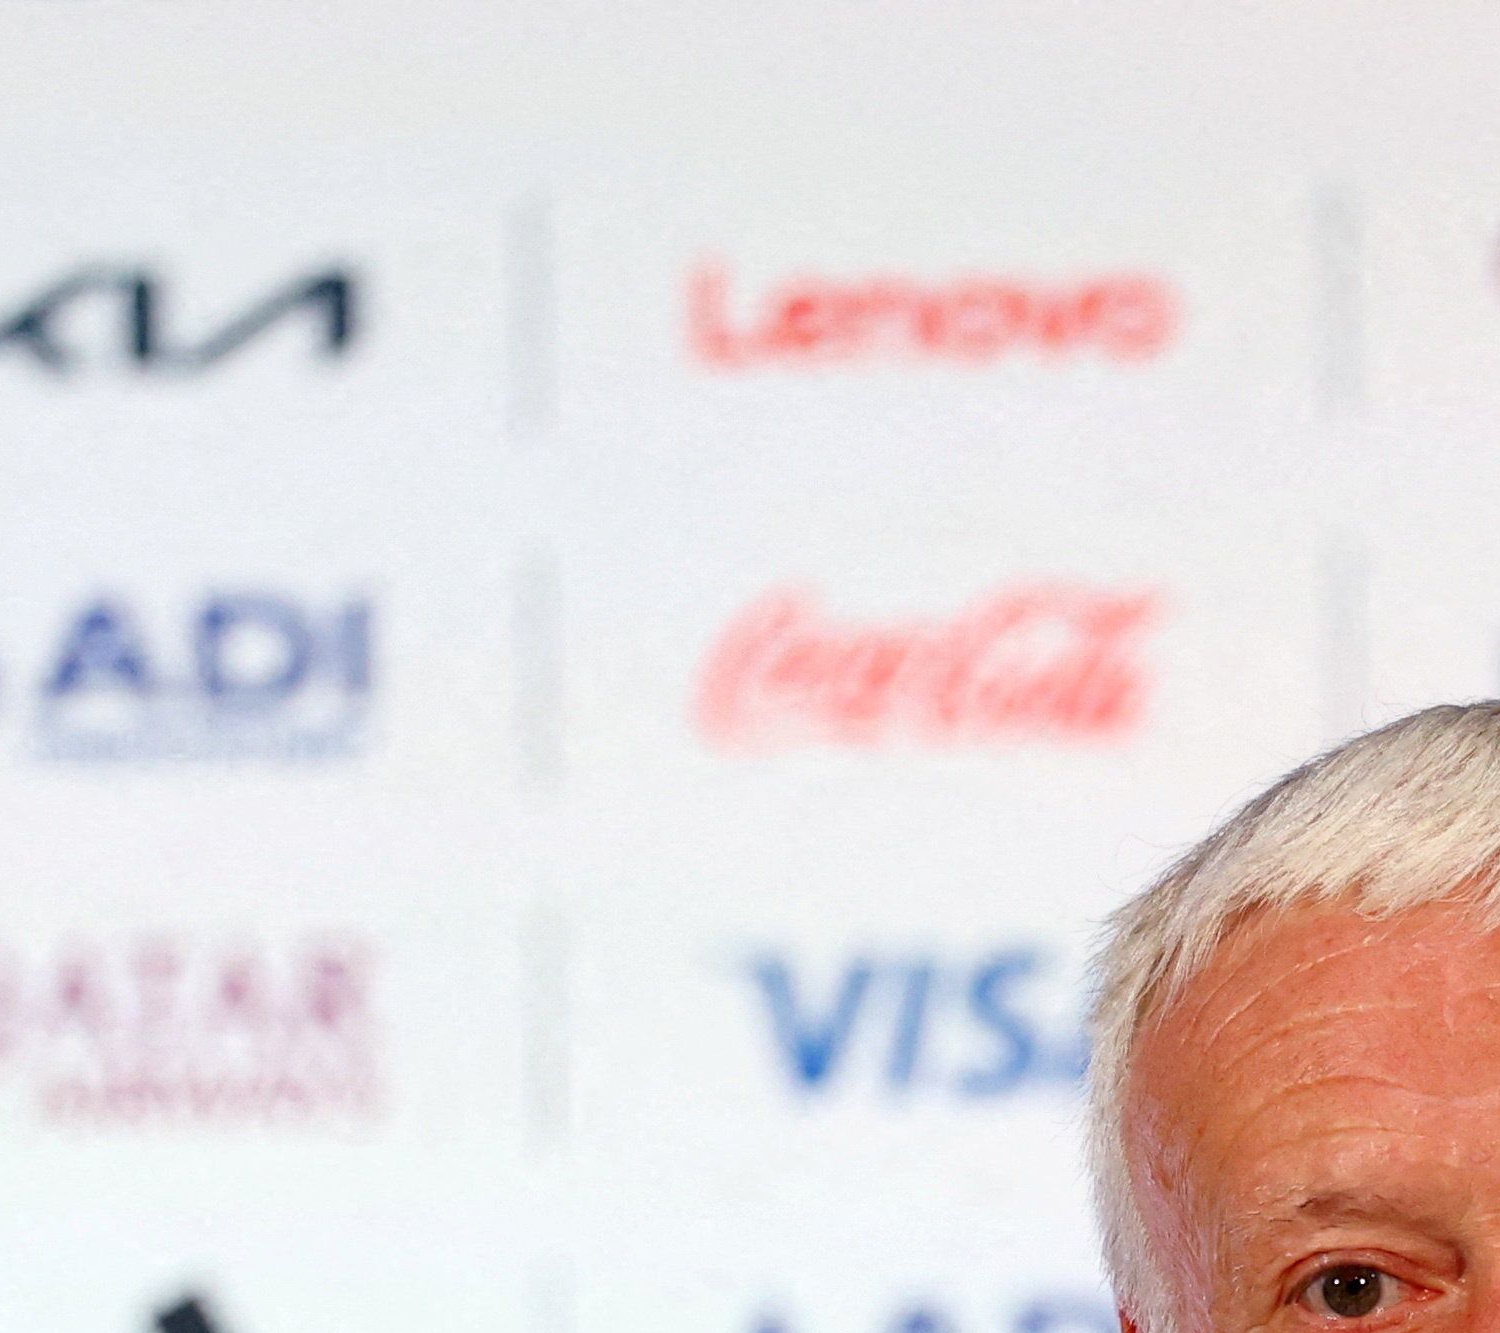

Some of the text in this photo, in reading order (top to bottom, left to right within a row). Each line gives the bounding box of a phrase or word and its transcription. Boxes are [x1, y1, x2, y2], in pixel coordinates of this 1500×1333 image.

[692, 272, 1174, 366] Lenovo
[38, 593, 374, 698] ADI
[740, 946, 1090, 1100] VIS
